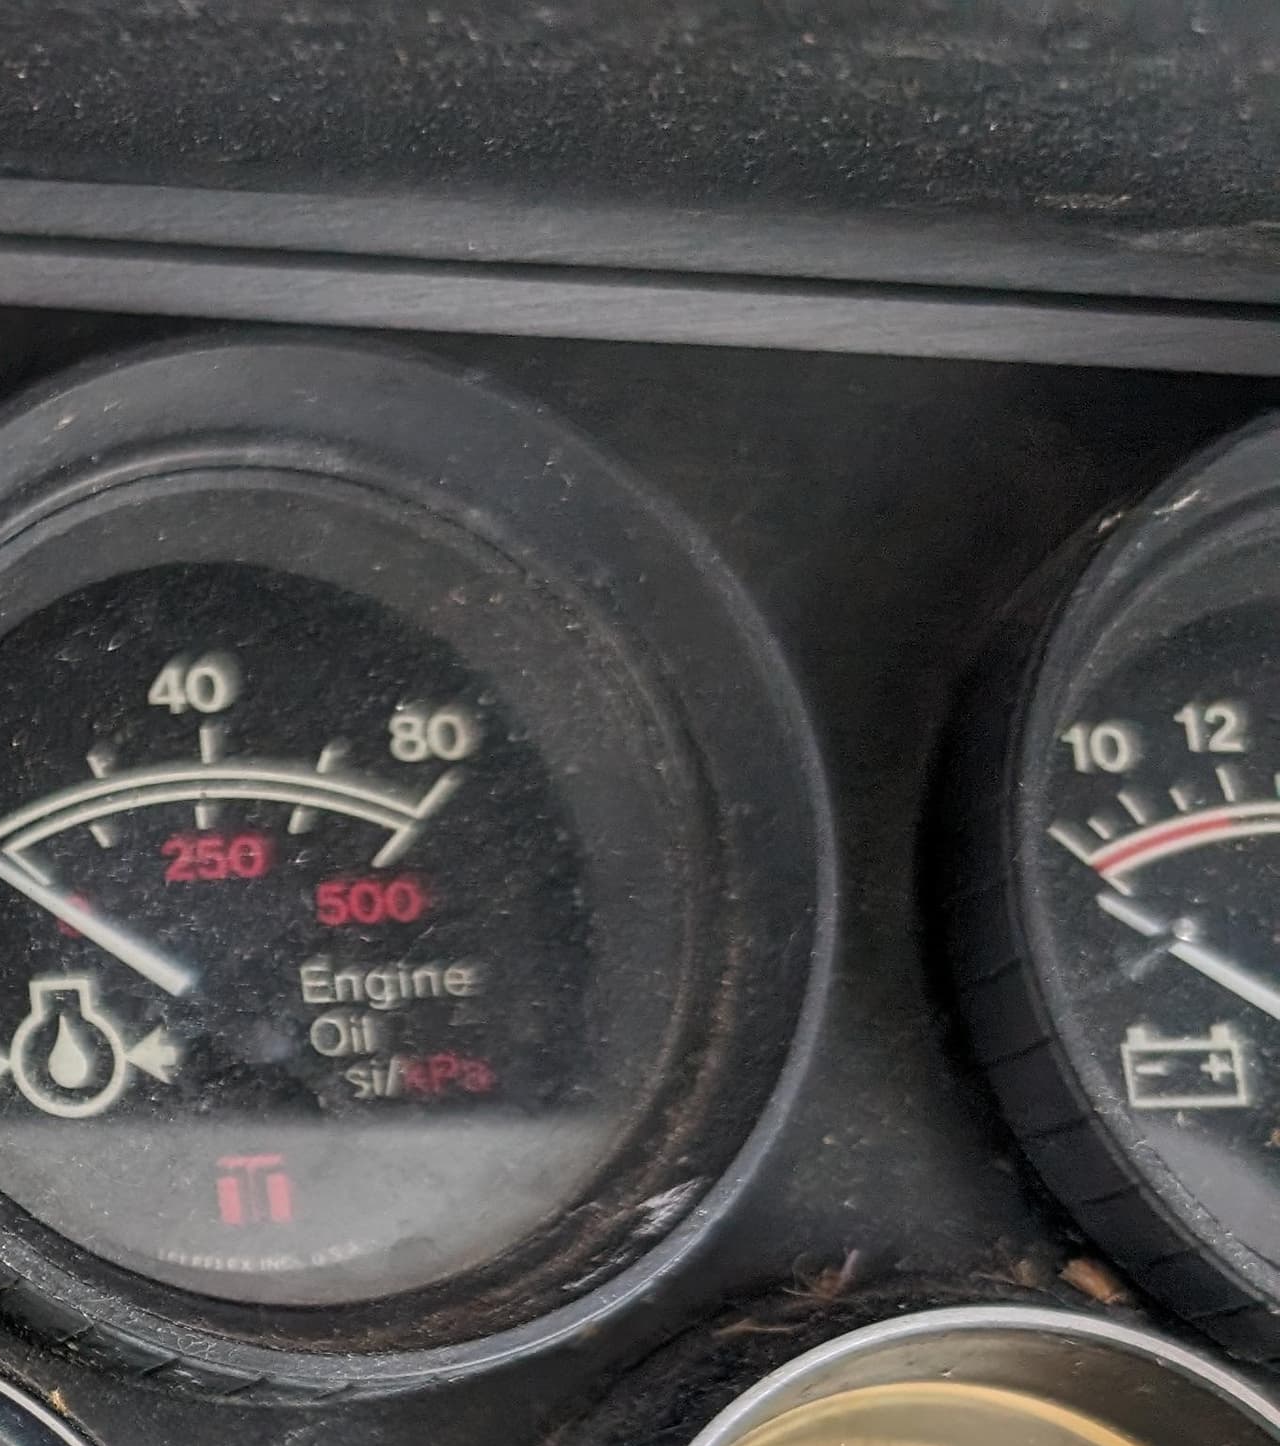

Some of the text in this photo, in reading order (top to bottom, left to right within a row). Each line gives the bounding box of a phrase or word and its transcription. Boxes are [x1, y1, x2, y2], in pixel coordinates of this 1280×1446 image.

[148, 659, 237, 714] 40
[388, 712, 477, 763] 80
[1060, 723, 1132, 774] 10
[1174, 704, 1246, 753] 12
[162, 836, 271, 882] 250
[317, 881, 427, 925] 500
[300, 960, 480, 1011] Engine
[310, 1012, 378, 1057] Oil
